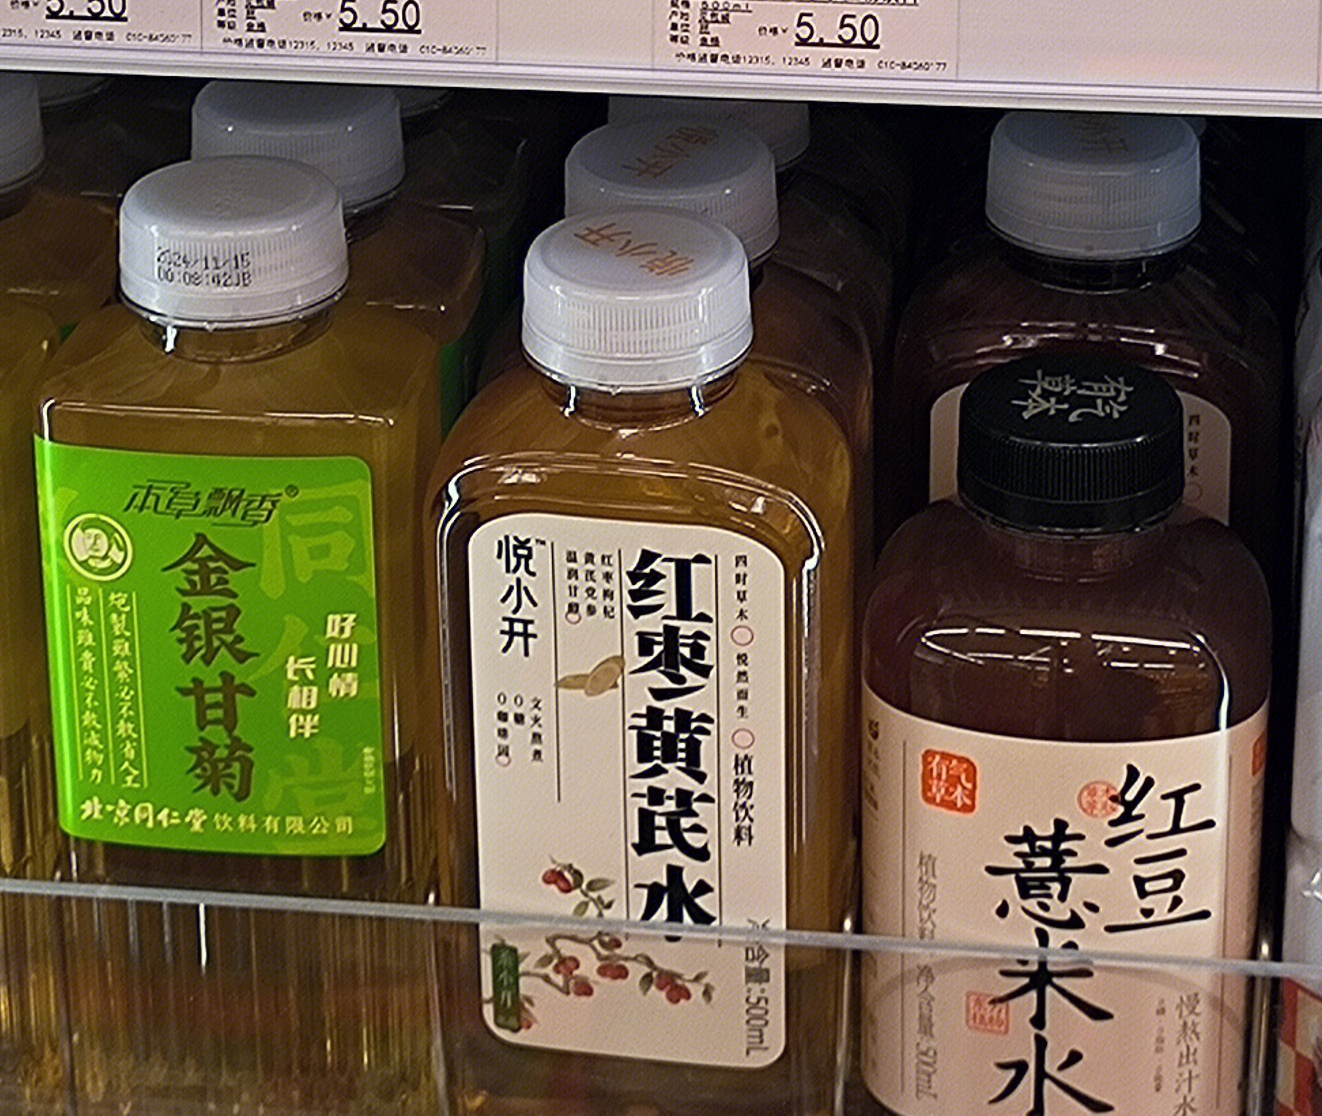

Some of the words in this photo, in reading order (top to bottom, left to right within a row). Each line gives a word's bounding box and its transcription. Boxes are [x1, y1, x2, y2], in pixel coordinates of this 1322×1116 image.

[795, 12, 880, 45] 5.50
[123, 478, 283, 527] 本草飘香
[496, 534, 538, 658] 悦小开
[733, 554, 750, 623] 四时草木
[161, 532, 260, 803] 金银甘菊
[285, 656, 320, 739] 长相伴
[326, 613, 360, 700] 好心情
[734, 652, 751, 719] 悦然而生
[626, 547, 719, 944] 红枣黄芪水
[78, 795, 355, 835] 北京同仁堂饮料有限公司
[732, 754, 755, 848] 植物饮料
[1104, 764, 1217, 933] 红豆
[984, 818, 1114, 1116] 薏米水
[1174, 991, 1202, 1116] 慢熬出汁水
